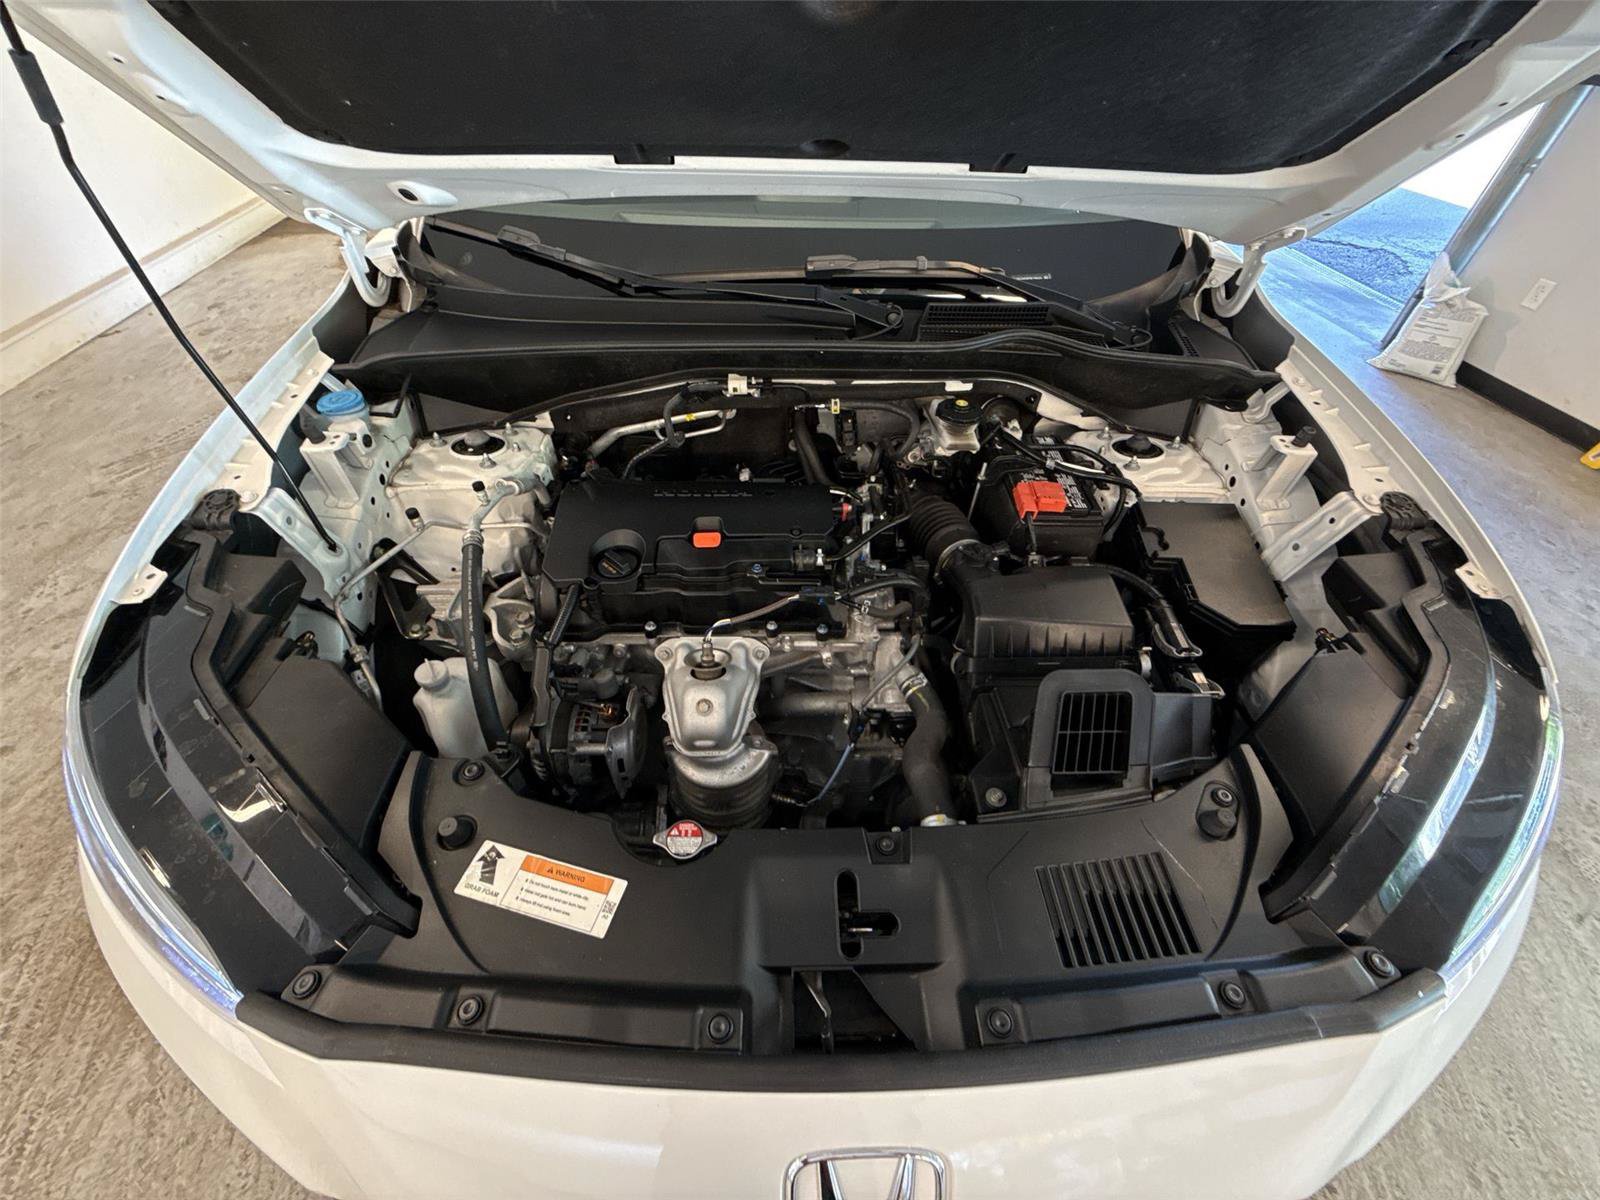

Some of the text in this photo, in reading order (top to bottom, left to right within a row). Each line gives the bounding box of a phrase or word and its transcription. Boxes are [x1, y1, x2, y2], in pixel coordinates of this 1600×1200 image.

[555, 869, 585, 883] WARNING
[464, 882, 500, 898] GRAB FOAM
